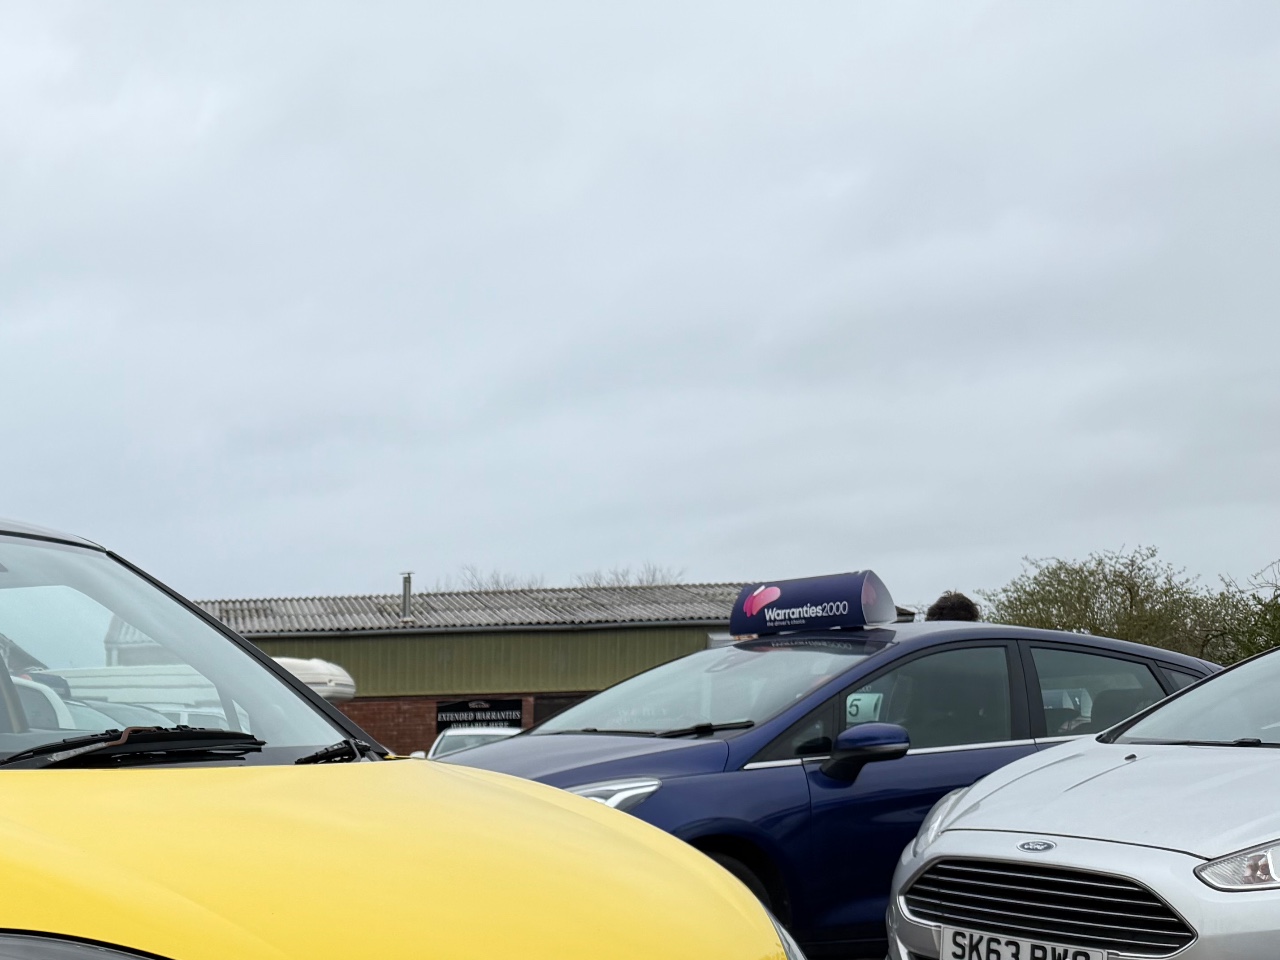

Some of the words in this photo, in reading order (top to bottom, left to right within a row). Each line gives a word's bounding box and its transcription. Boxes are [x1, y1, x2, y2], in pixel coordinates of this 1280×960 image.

[764, 601, 849, 620] Warranties2000
[438, 711, 475, 721] EXTENDED
[476, 709, 521, 720] WARRANTIES
[849, 698, 861, 717] 5
